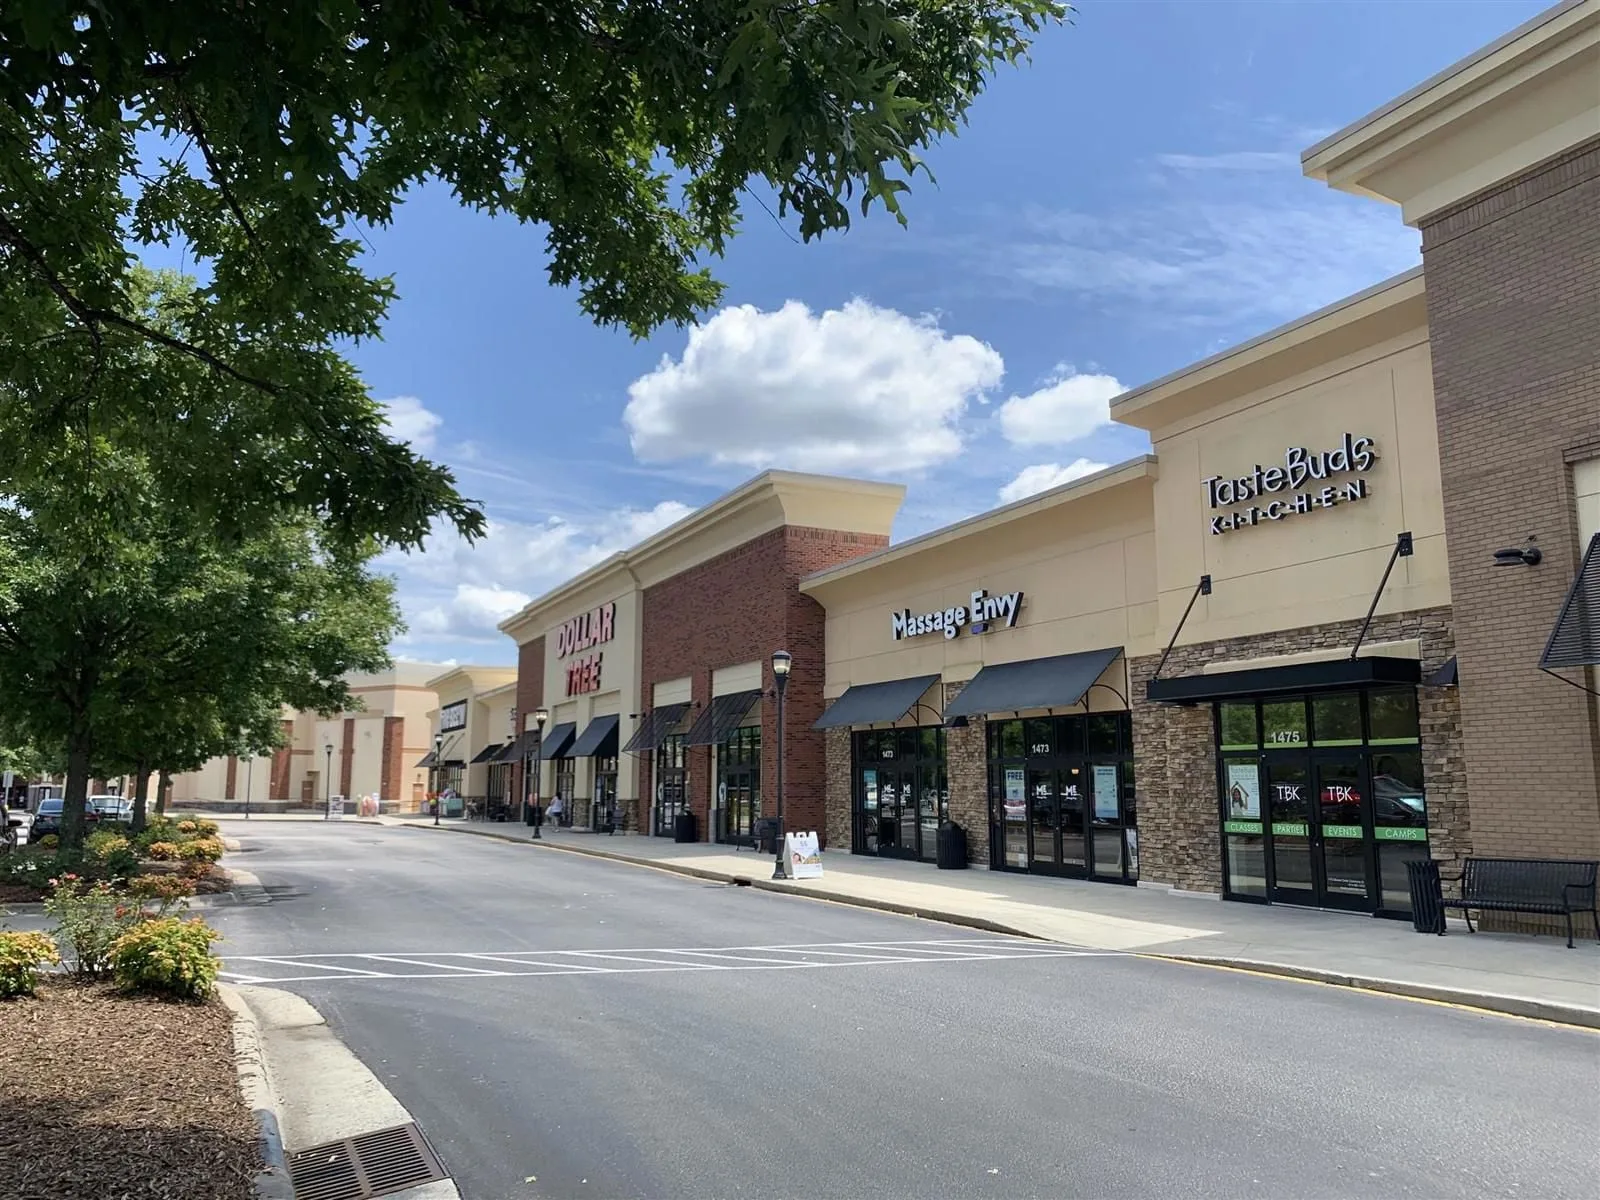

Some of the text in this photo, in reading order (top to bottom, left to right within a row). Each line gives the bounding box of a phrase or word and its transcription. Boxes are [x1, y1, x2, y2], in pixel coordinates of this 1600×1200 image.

[892, 589, 1024, 641] Massage Envy
[556, 602, 617, 661] DOLLAR
[565, 651, 603, 697] TREE
[1270, 731, 1300, 744] 1475
[1032, 744, 1050, 753] 1473
[1007, 771, 1024, 781] FREE
[1065, 785, 1077, 796] ME
[1276, 786, 1300, 801] TBK
[1327, 786, 1353, 802] TBK
[1230, 823, 1258, 833] CLASSES
[1276, 825, 1305, 835] PARTIES
[1328, 828, 1357, 837] EVENTS
[1385, 829, 1417, 839] CAMPS
